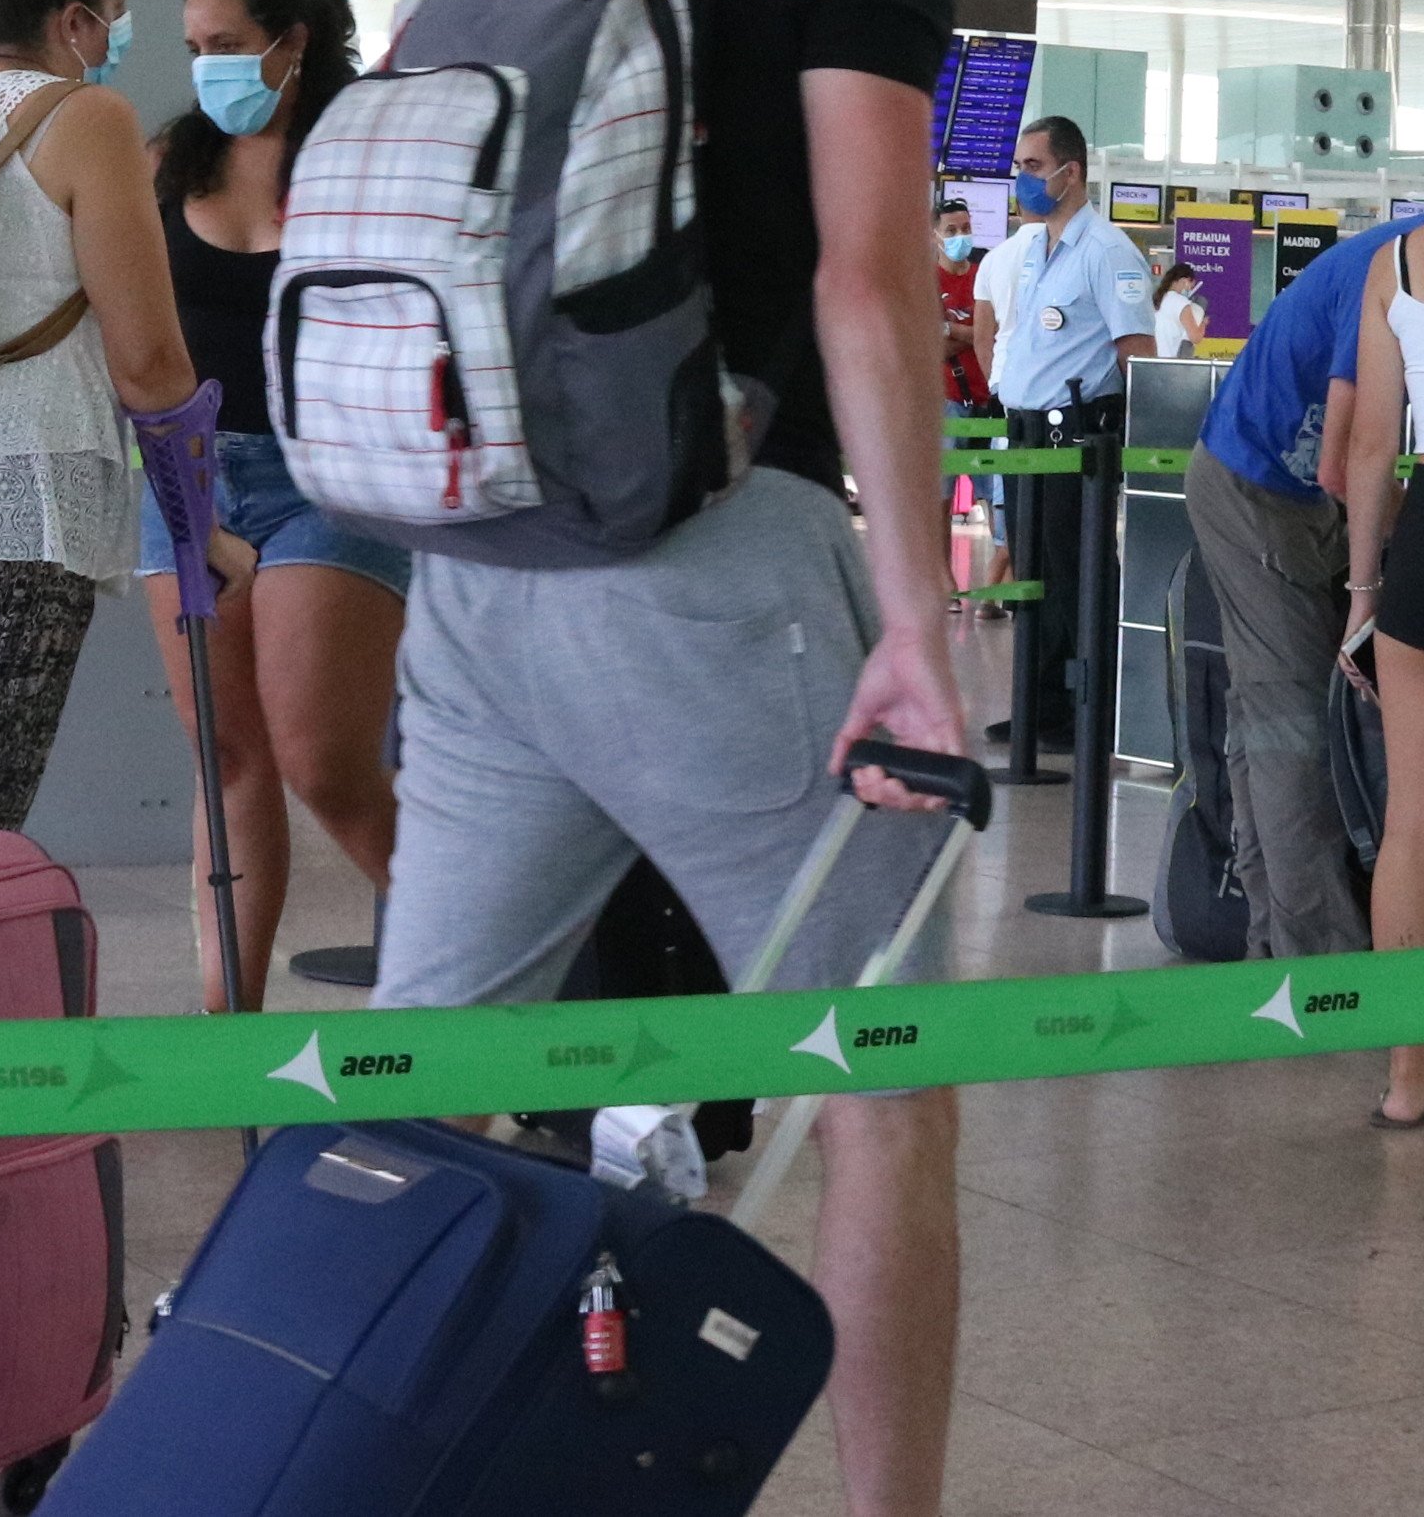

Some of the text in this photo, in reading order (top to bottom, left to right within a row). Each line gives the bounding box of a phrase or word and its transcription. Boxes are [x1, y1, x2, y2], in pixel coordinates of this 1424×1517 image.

[1115, 189, 1148, 200] CHECK-IN
[1265, 198, 1296, 208] CHECK-IN
[1183, 232, 1231, 243] PREMIUM
[1283, 236, 1321, 248] MADRID
[1183, 245, 1231, 257] TIMEFLEX
[1185, 262, 1224, 273] heck-in
[1303, 989, 1360, 1016] aena
[853, 1023, 919, 1049] aena
[339, 1050, 414, 1078] aena
